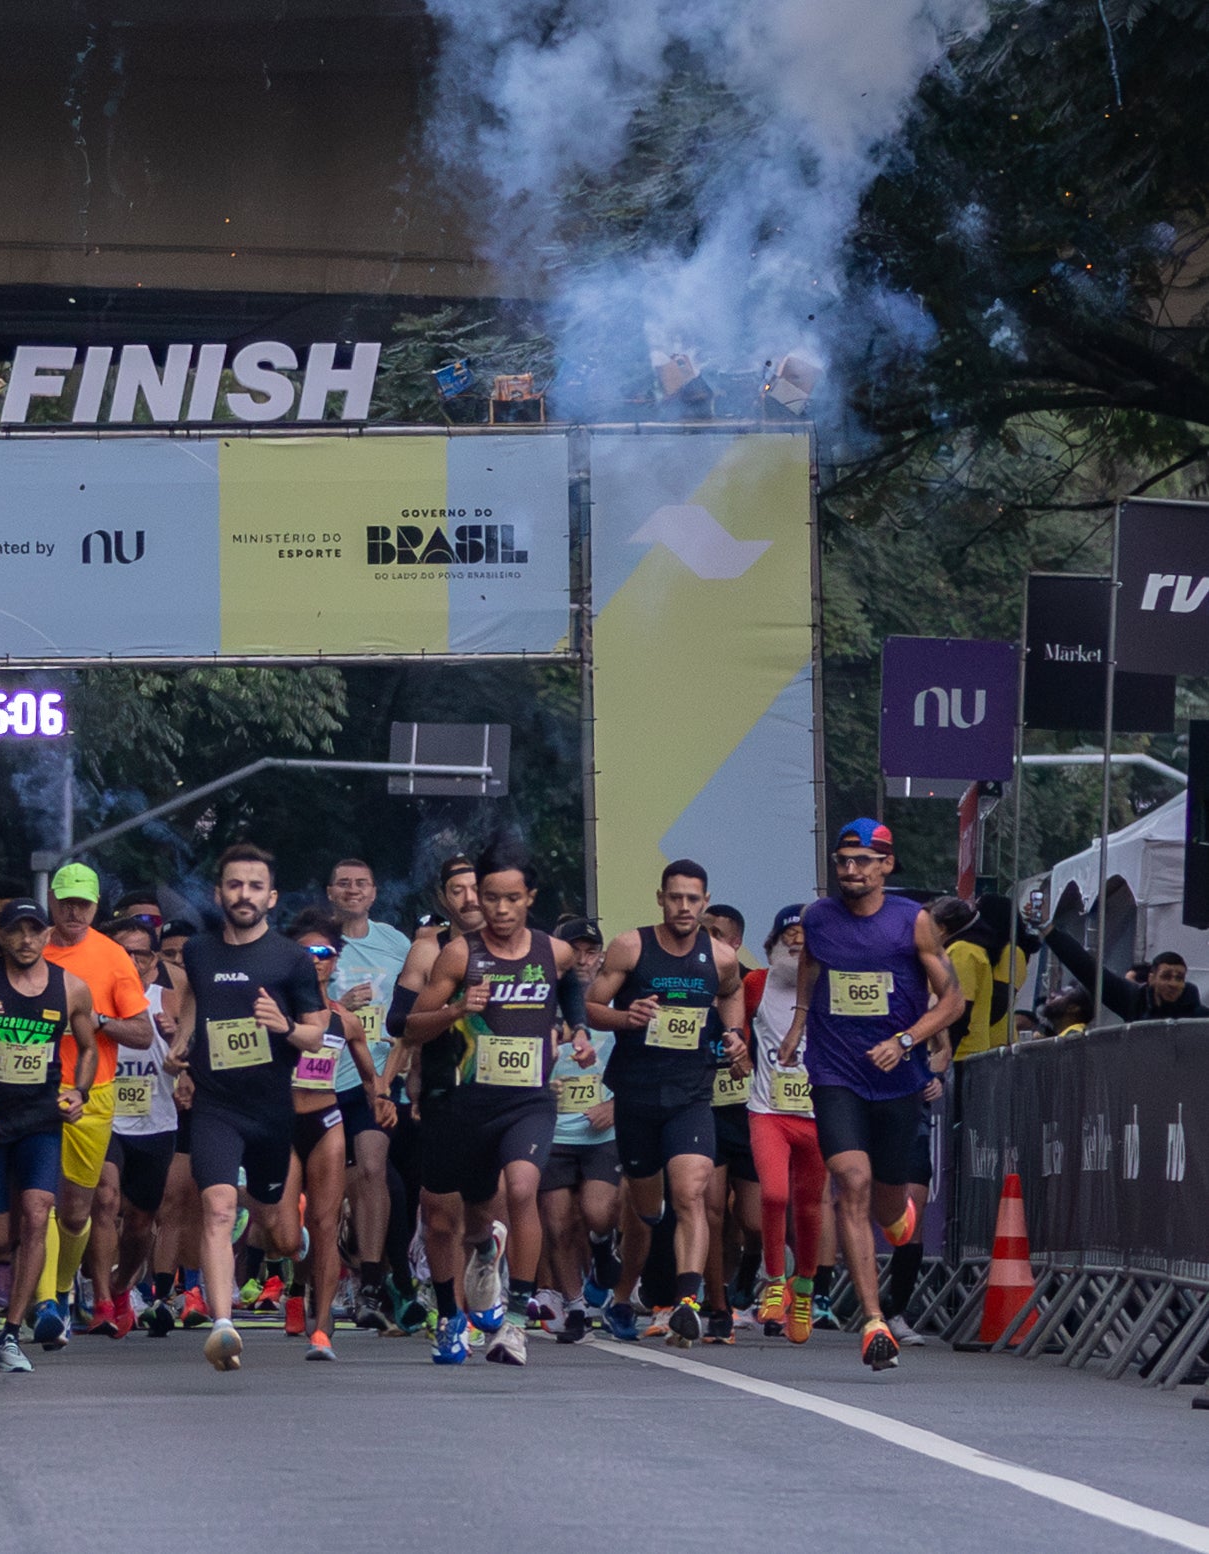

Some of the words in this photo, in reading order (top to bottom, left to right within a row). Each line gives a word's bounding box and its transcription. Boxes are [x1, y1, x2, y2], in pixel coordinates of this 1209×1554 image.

[0, 341, 382, 424] FINISH
[401, 509, 467, 518] GOVERNO
[474, 508, 493, 518] DO
[232, 532, 316, 544] MINISTÉRIO
[323, 532, 342, 543] DO
[366, 524, 528, 565] BRASIL
[36, 541, 55, 557] by
[278, 548, 342, 558] ESPORTE
[375, 572, 389, 580] DO
[391, 572, 418, 580] LADO
[652, 977, 705, 989] GREENLIFE
[848, 984, 880, 1000] 665
[668, 1018, 696, 1035] 684
[227, 1031, 259, 1051] 601
[13, 1055, 42, 1070] 765
[306, 1058, 332, 1074] 440
[498, 1050, 530, 1069] 660
[568, 1084, 595, 1100] 773
[719, 1079, 745, 1093] 813
[784, 1083, 810, 1097] 502
[118, 1087, 146, 1102] 692
